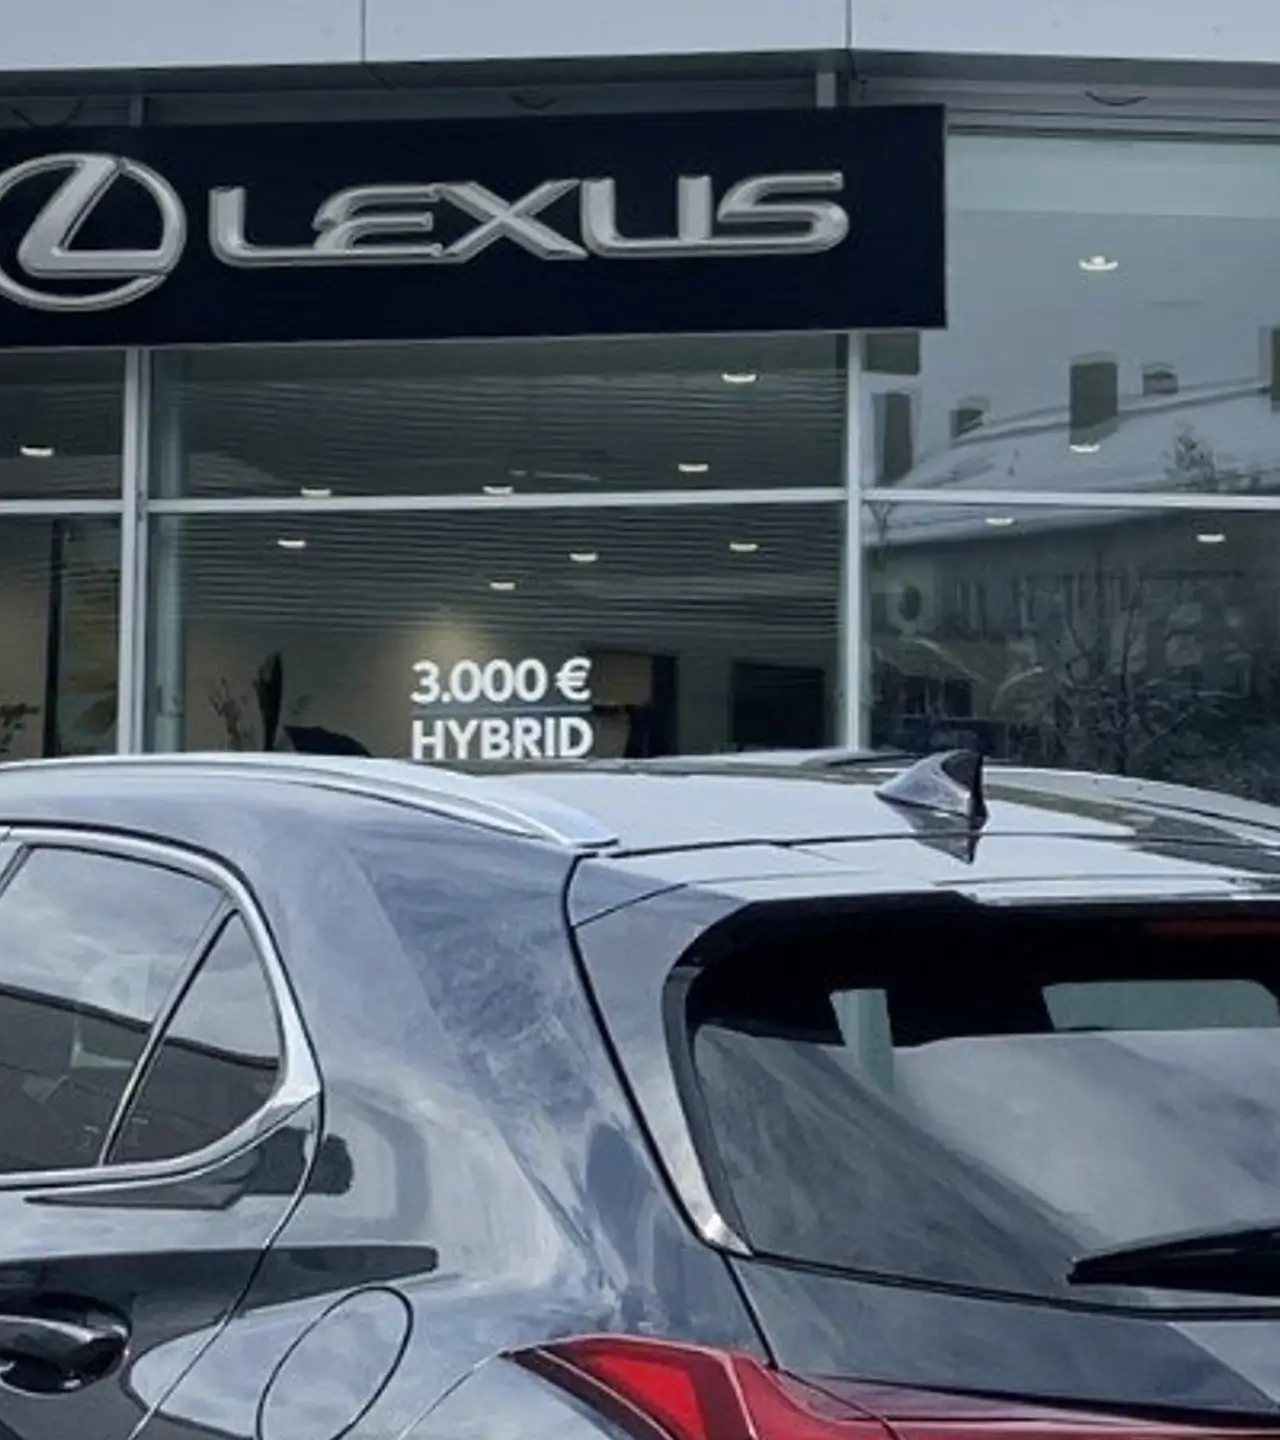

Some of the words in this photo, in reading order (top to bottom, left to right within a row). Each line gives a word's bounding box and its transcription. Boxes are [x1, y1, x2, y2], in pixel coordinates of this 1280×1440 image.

[208, 171, 850, 267] LEXUS
[410, 658, 548, 703] 3.000
[555, 657, 592, 701] €
[410, 716, 595, 760] HYBRID
